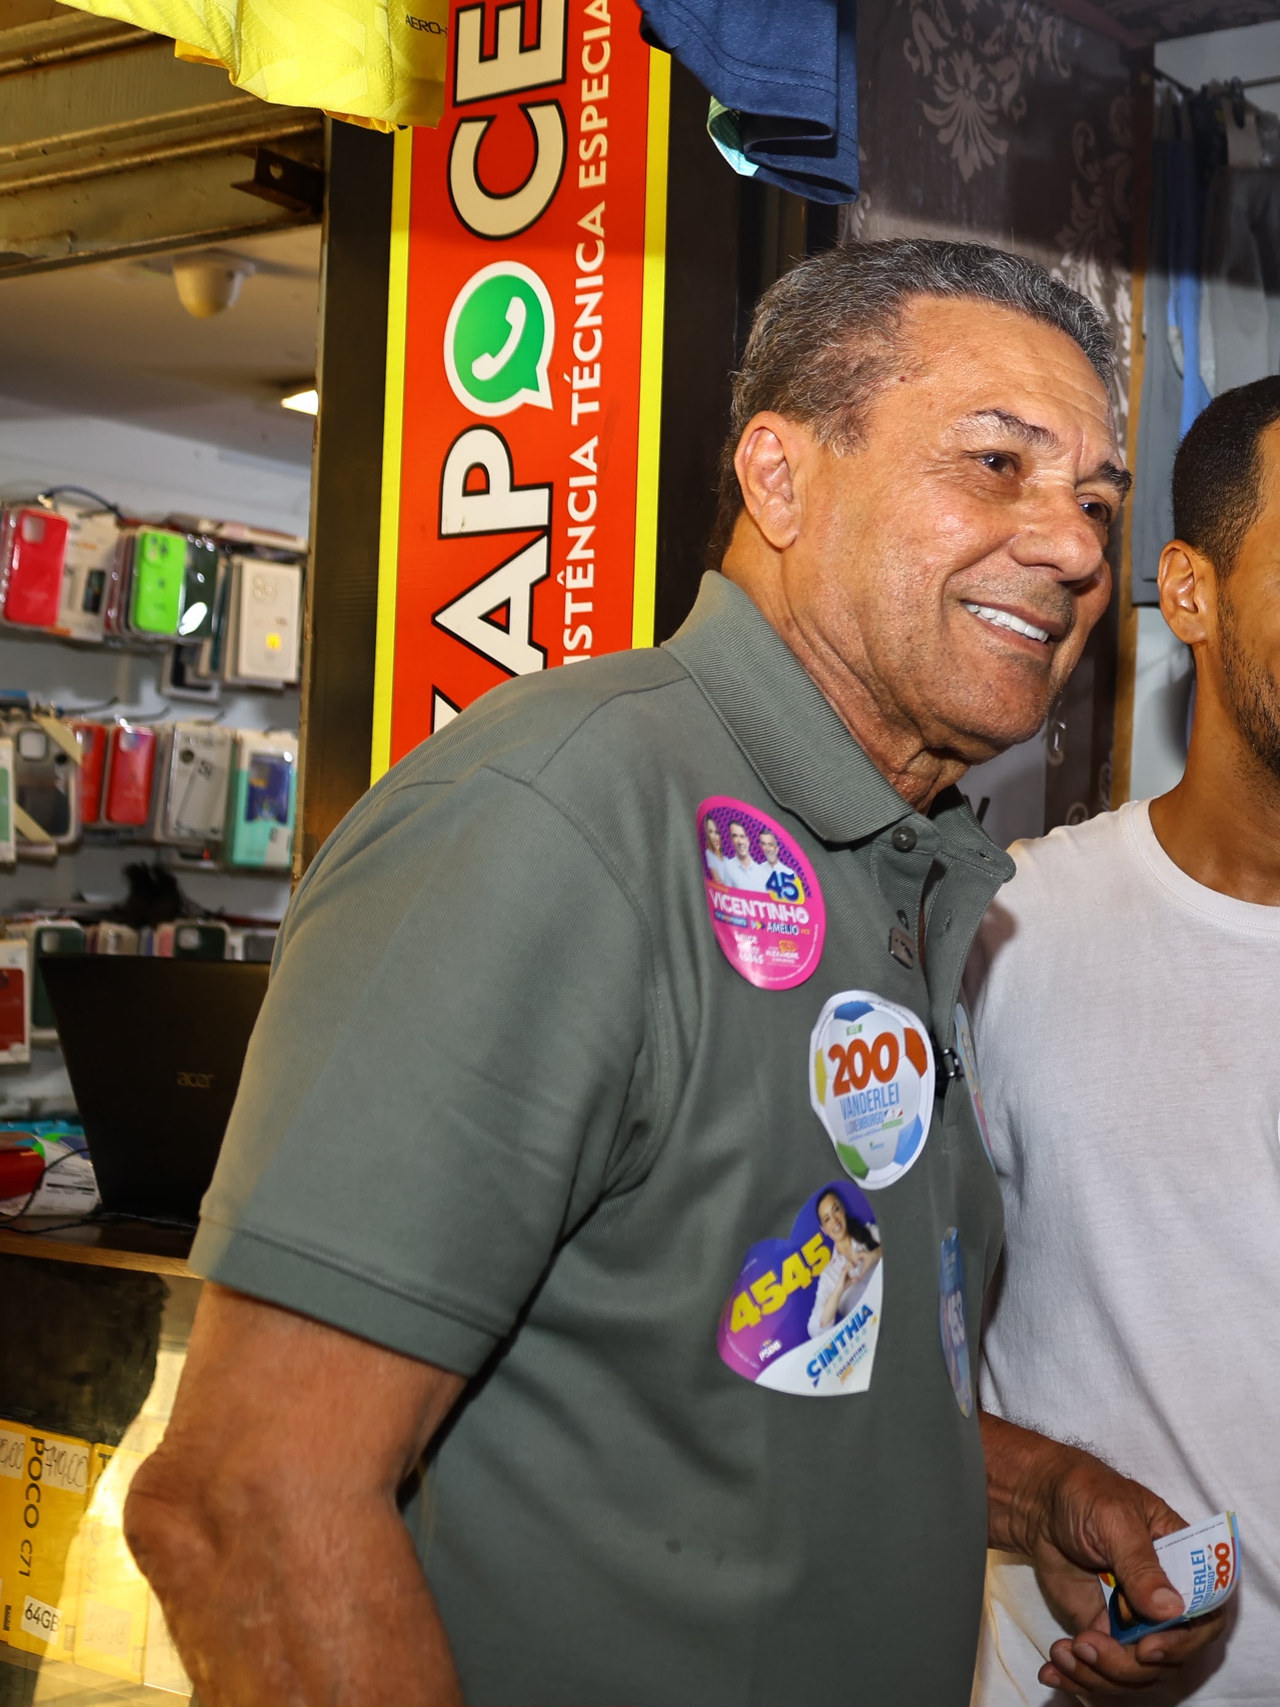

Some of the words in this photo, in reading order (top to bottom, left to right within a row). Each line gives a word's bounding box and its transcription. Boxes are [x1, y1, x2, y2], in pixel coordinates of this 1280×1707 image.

[563, 200, 606, 425] TÉCNICA
[431, 424, 553, 736] AP
[556, 435, 599, 666] ISTÊNCIA
[709, 888, 809, 924] VICENTINHO
[765, 870, 799, 901] 45
[827, 1031, 900, 1098] 200
[839, 1082, 900, 1120] VANDERLEI
[729, 1232, 832, 1334] 4545
[806, 1303, 874, 1379] CINTHIA
[23, 1436, 45, 1529] POCO
[18, 1539, 33, 1578] C71
[1213, 1542, 1231, 1592] 200
[25, 1602, 60, 1632] 64GB
